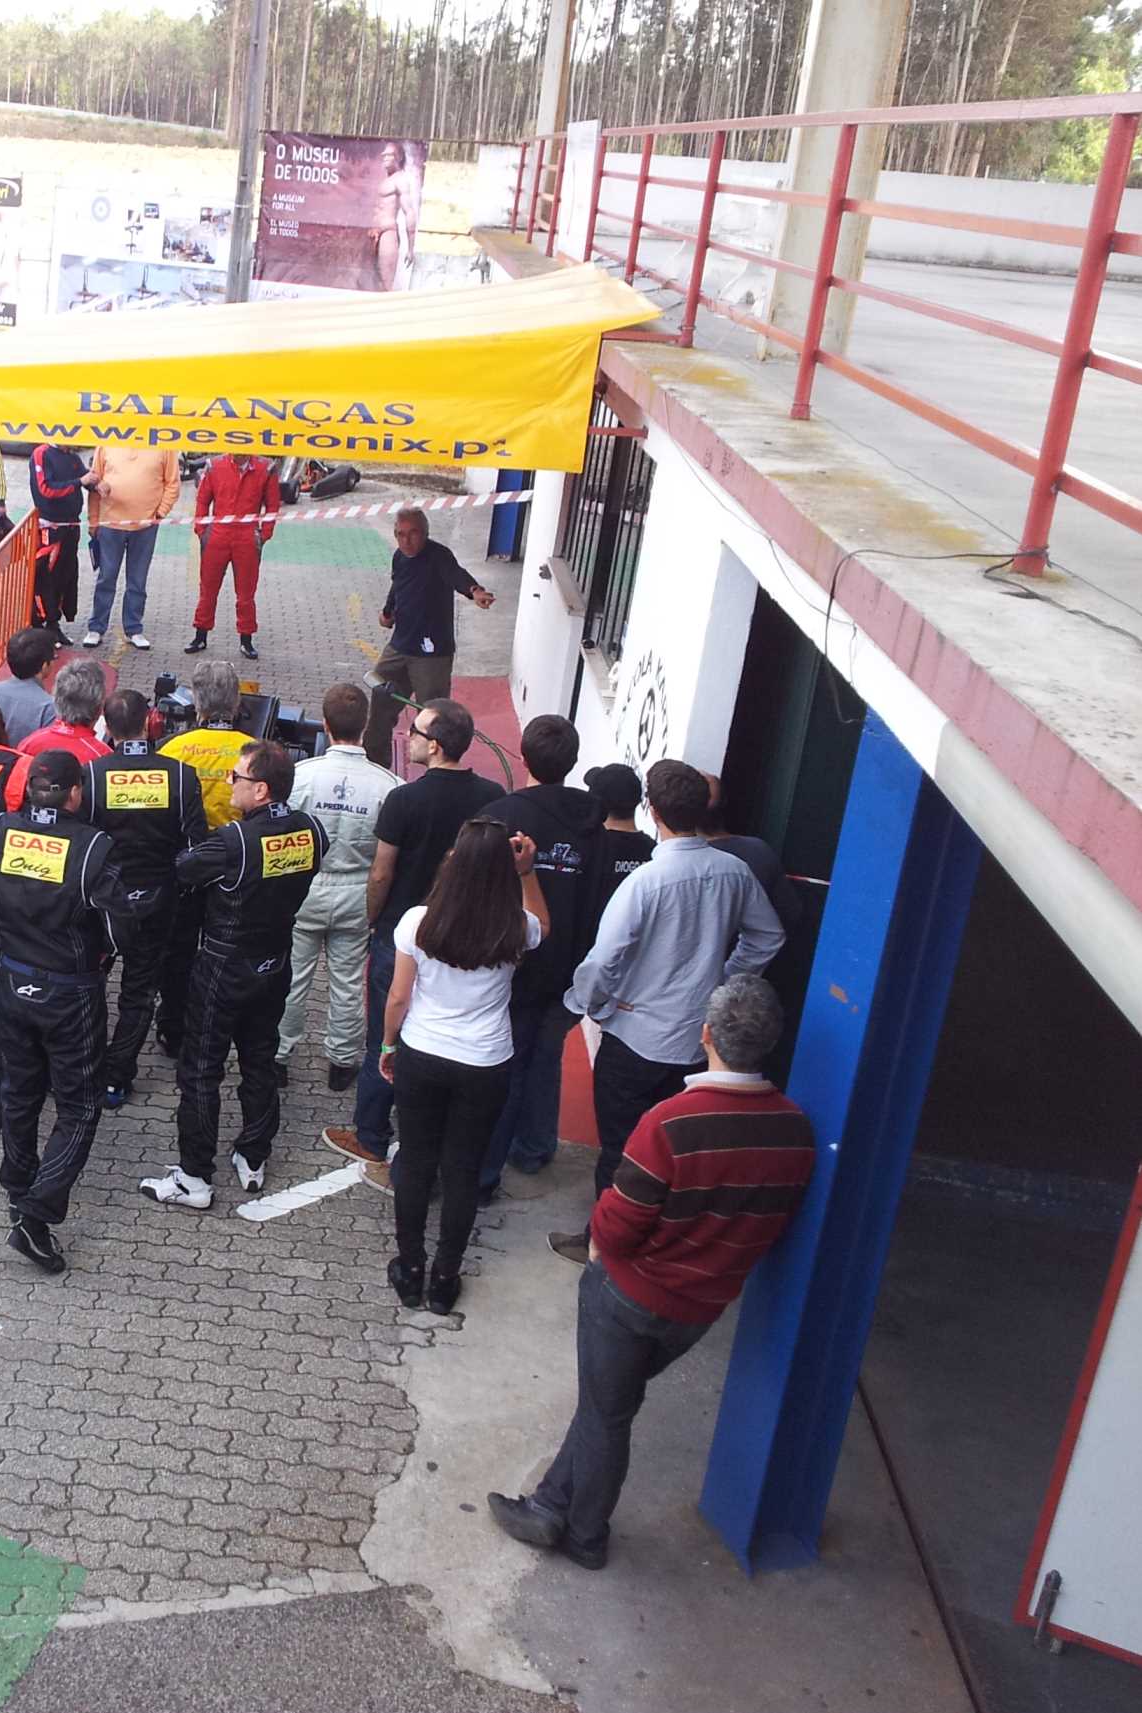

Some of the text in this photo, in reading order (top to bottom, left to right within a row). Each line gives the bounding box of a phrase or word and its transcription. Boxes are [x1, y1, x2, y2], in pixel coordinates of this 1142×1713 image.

[276, 143, 340, 164] O MUSEU
[274, 164, 339, 184] DE TODOS
[272, 192, 305, 203] A MUSEUM
[272, 202, 296, 211] FOR ALL
[269, 227, 277, 235] DE
[76, 391, 416, 428] BALANÇAS
[110, 773, 164, 786] GAS
[315, 801, 322, 809] A
[9, 834, 63, 855] GAS
[266, 833, 311, 852] GAS
